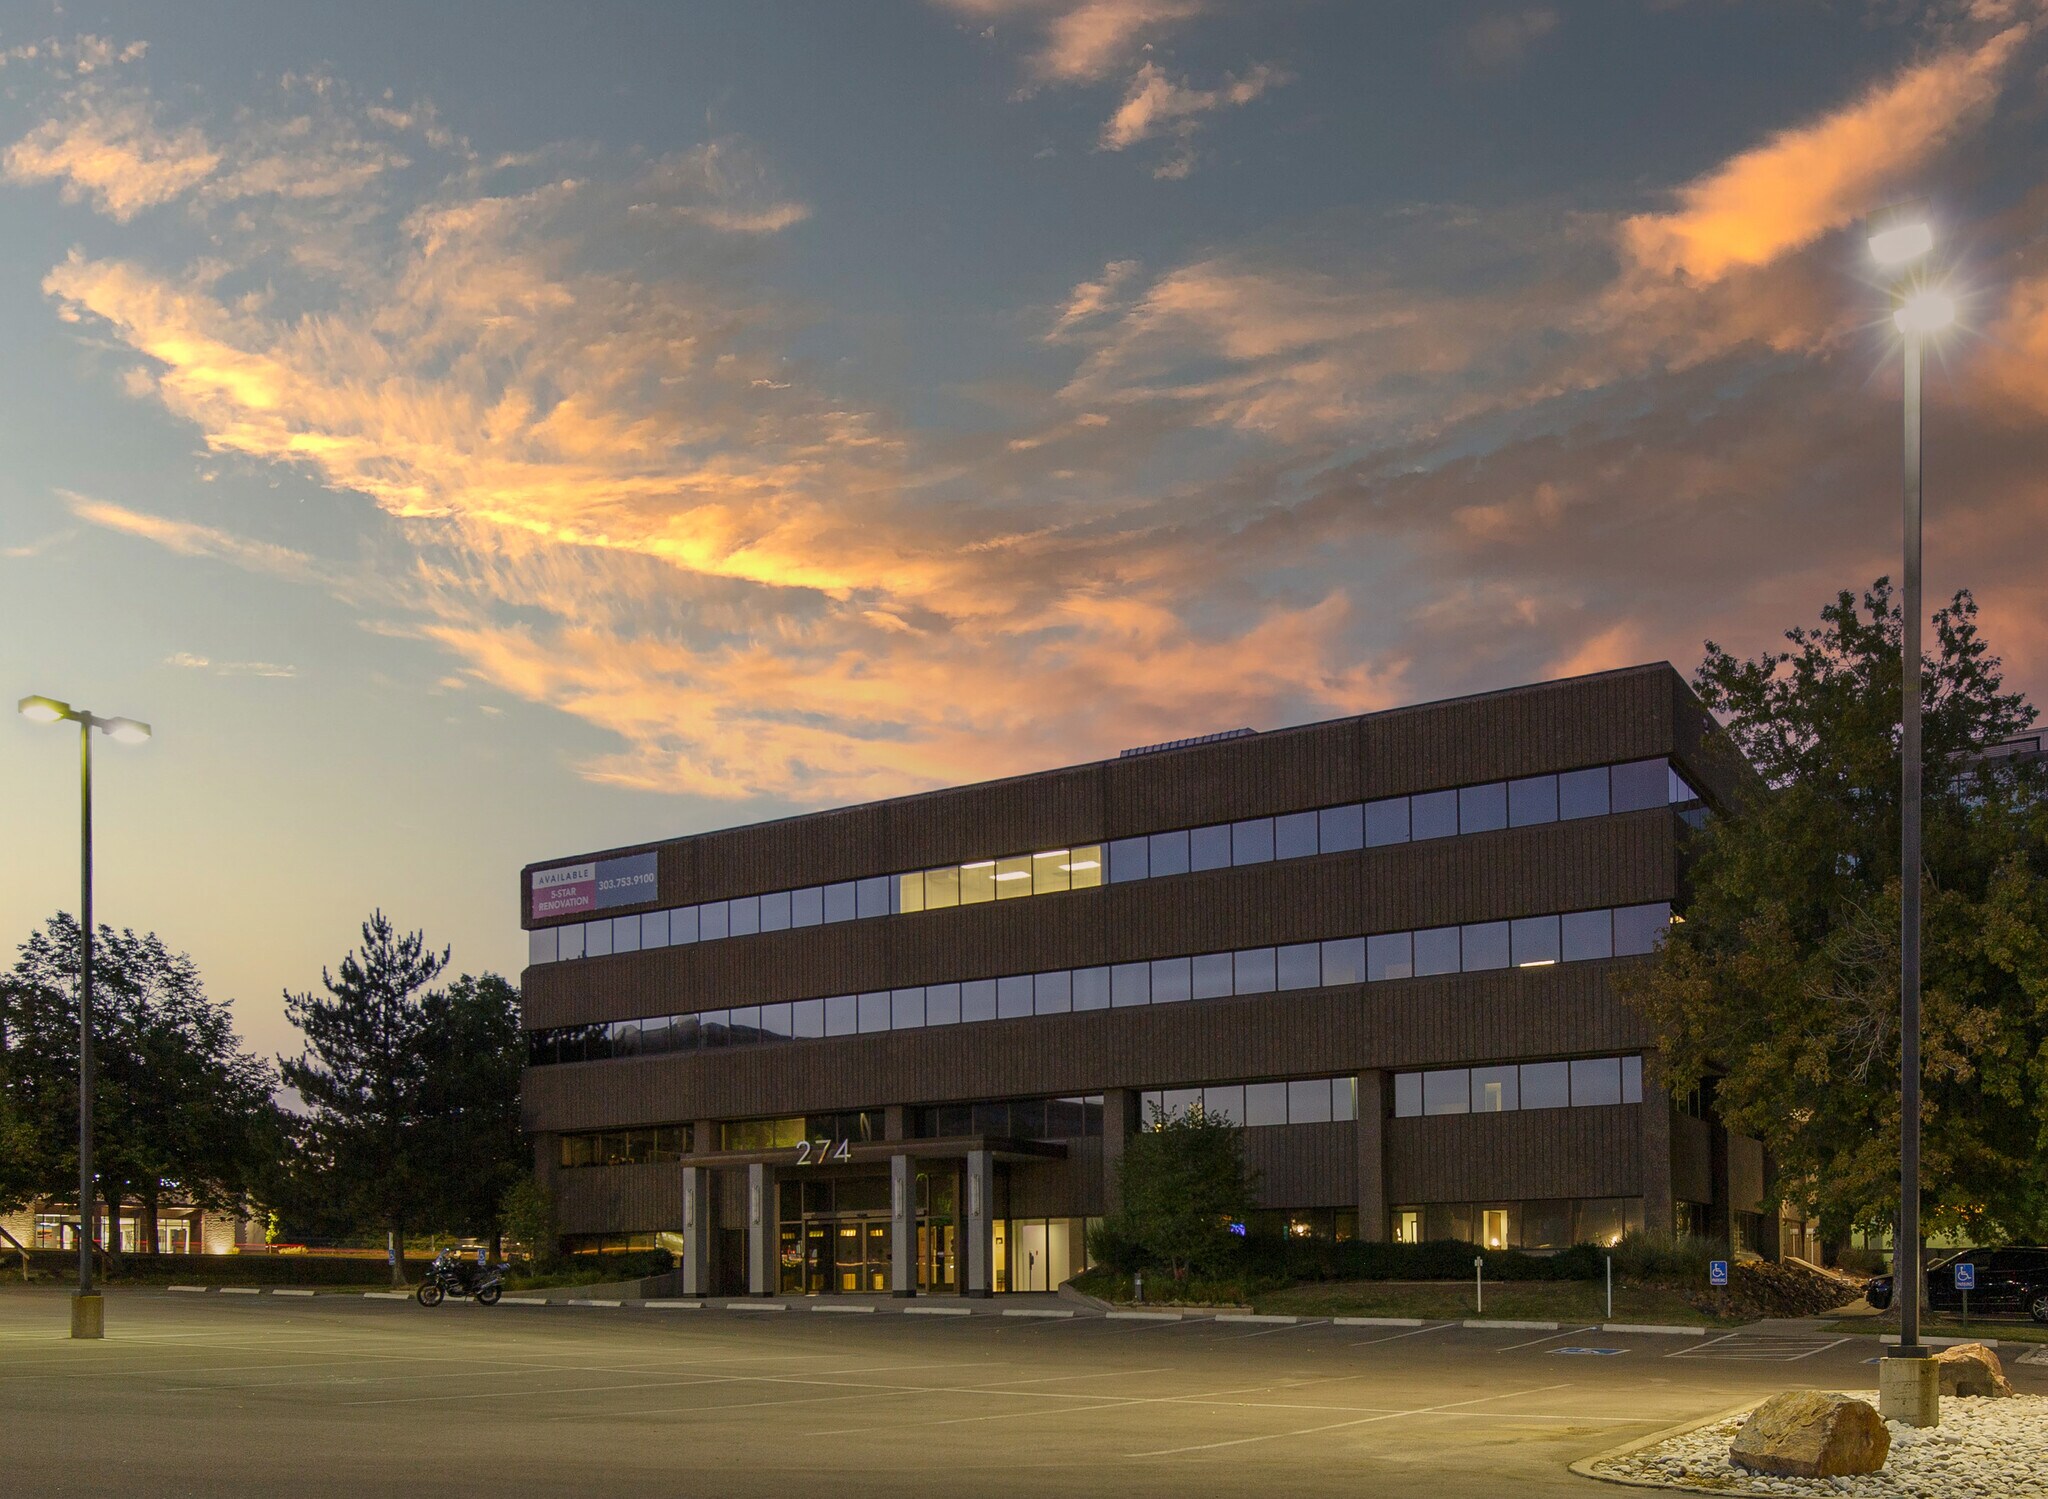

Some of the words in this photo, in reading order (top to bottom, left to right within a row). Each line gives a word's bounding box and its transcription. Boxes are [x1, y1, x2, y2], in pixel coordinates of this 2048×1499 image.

[539, 869, 588, 885] AVAILABLE
[598, 872, 655, 890] 303.753.9100
[551, 887, 577, 899] 5-STAR
[538, 896, 589, 911] RENOVATION
[796, 1138, 852, 1166] 274
